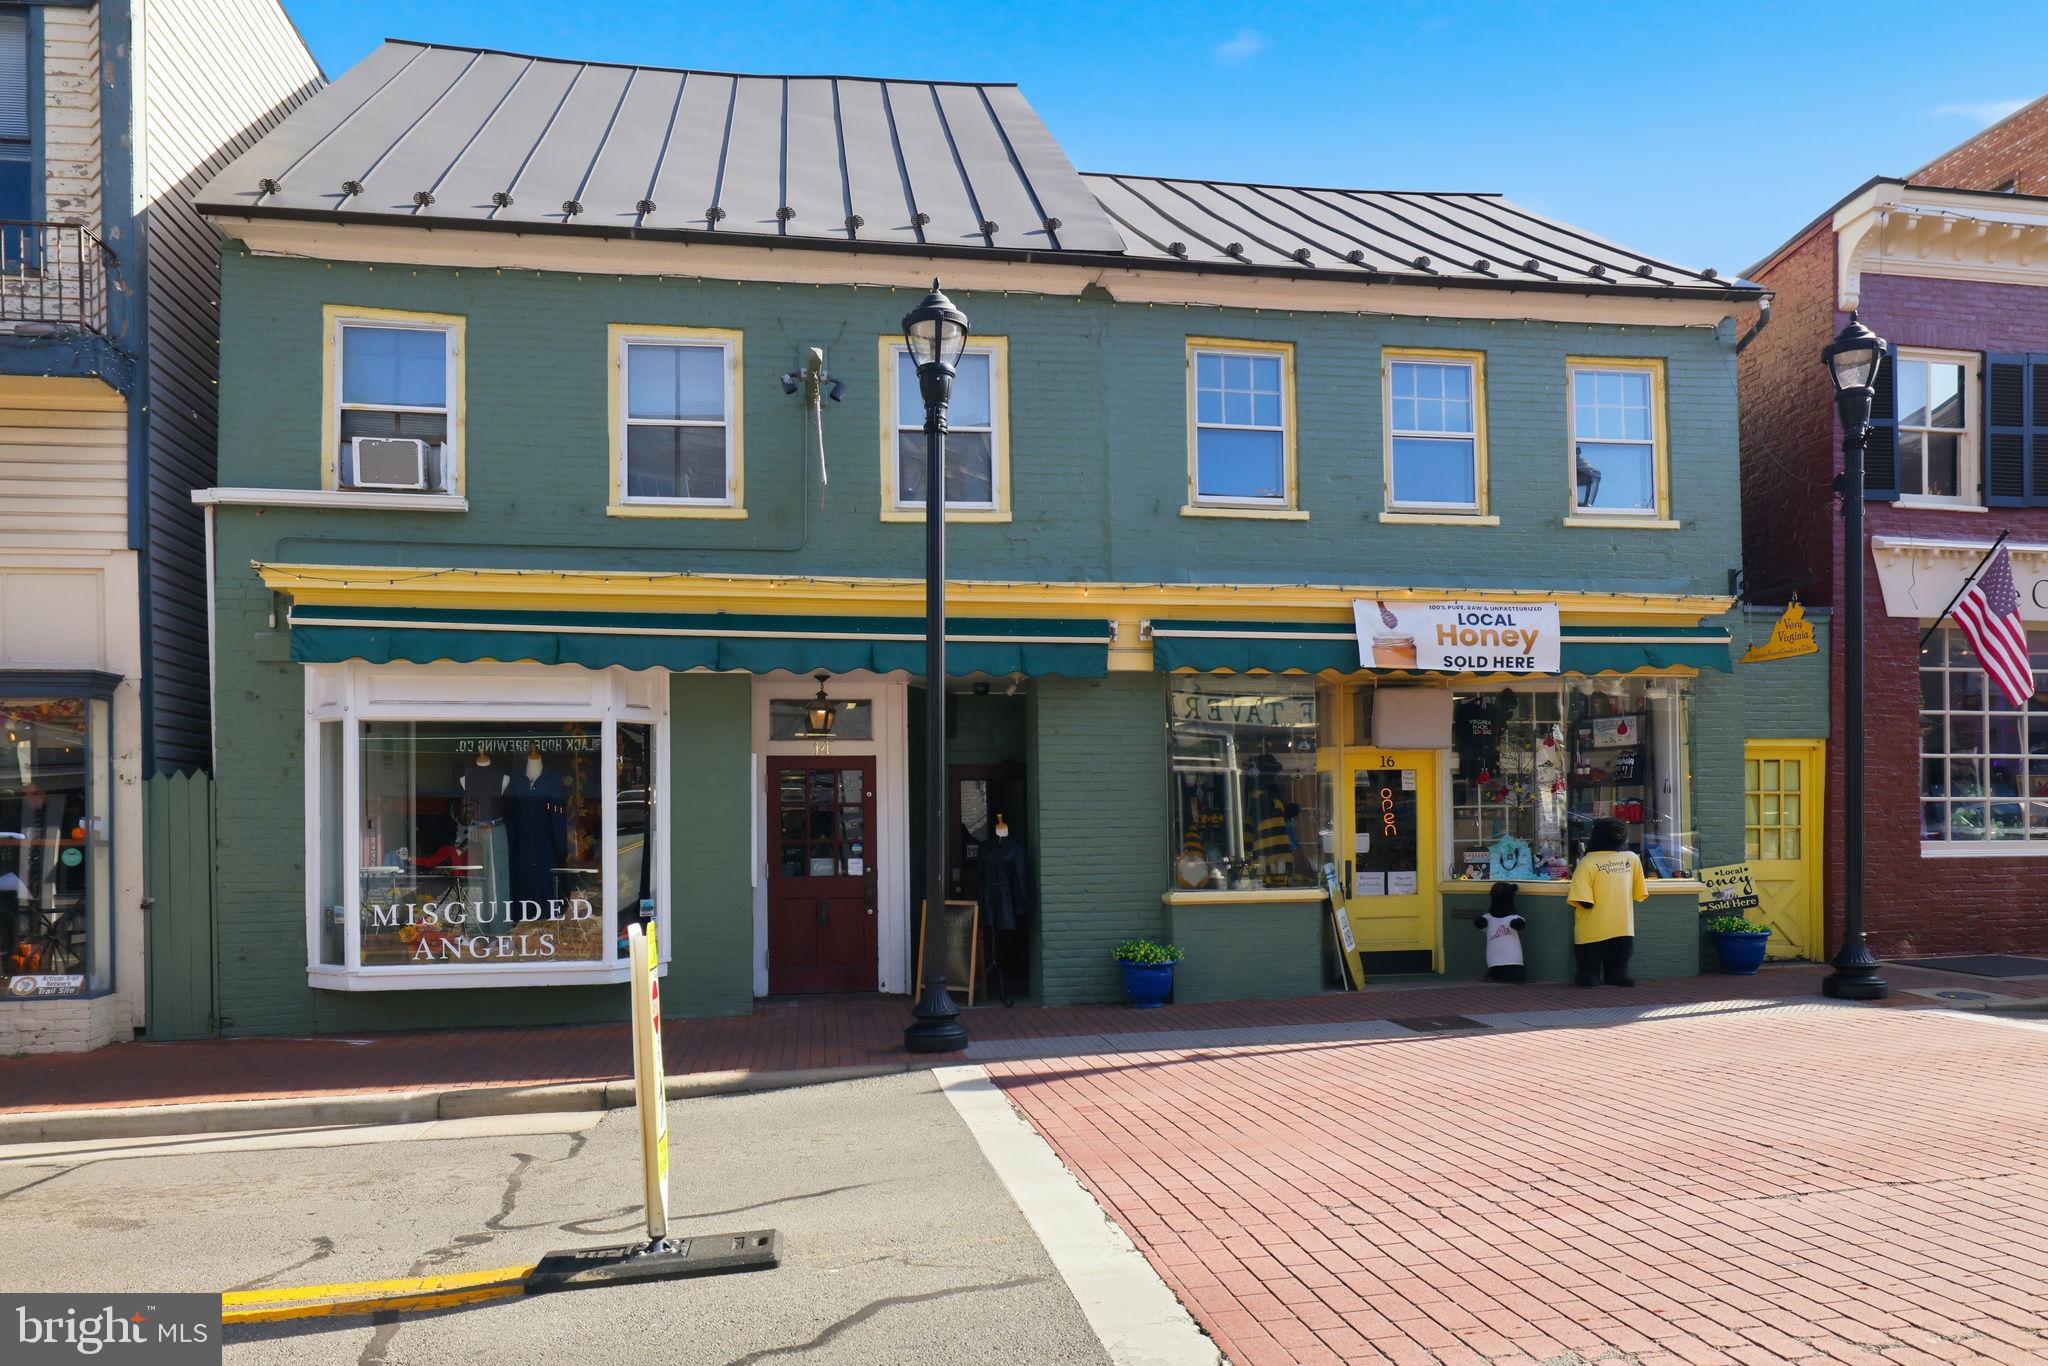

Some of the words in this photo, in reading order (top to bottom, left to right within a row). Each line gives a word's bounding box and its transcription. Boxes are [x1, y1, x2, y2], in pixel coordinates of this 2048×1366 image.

[1458, 612, 1517, 627] LOCAL
[1784, 618, 1803, 631] Very
[1436, 623, 1540, 655] Honey
[1777, 631, 1809, 644] Virginia
[1443, 655, 1488, 669] SOLD
[1493, 656, 1535, 669] HERE
[815, 740, 830, 756] 14
[1380, 755, 1395, 768] 16
[1720, 867, 1743, 876] Local
[1709, 901, 1730, 910] Sold
[1732, 898, 1757, 908] Here
[371, 899, 593, 927] MISGUIDED
[412, 933, 556, 960] ANGELS
[38, 987, 57, 995] Trail
